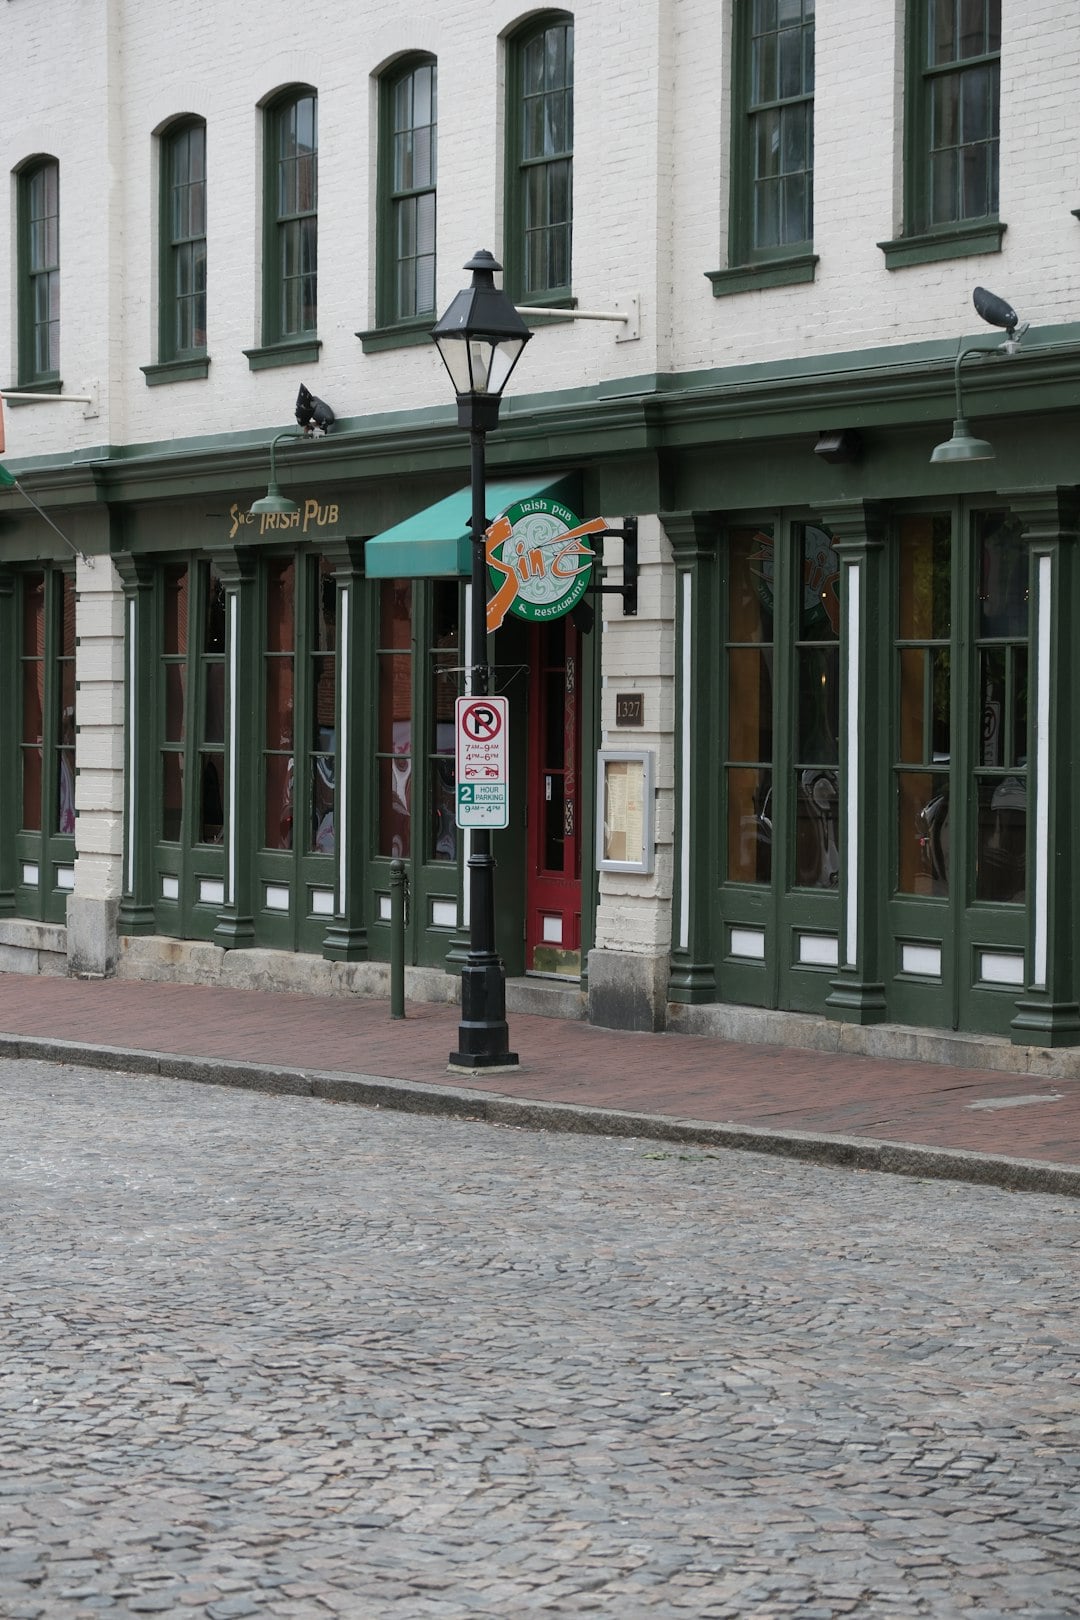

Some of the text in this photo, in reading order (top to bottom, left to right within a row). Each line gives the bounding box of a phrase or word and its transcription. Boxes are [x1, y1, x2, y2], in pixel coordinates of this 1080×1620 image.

[518, 604, 528, 615] &
[617, 701, 641, 718] 1327
[461, 786, 472, 801] 2
